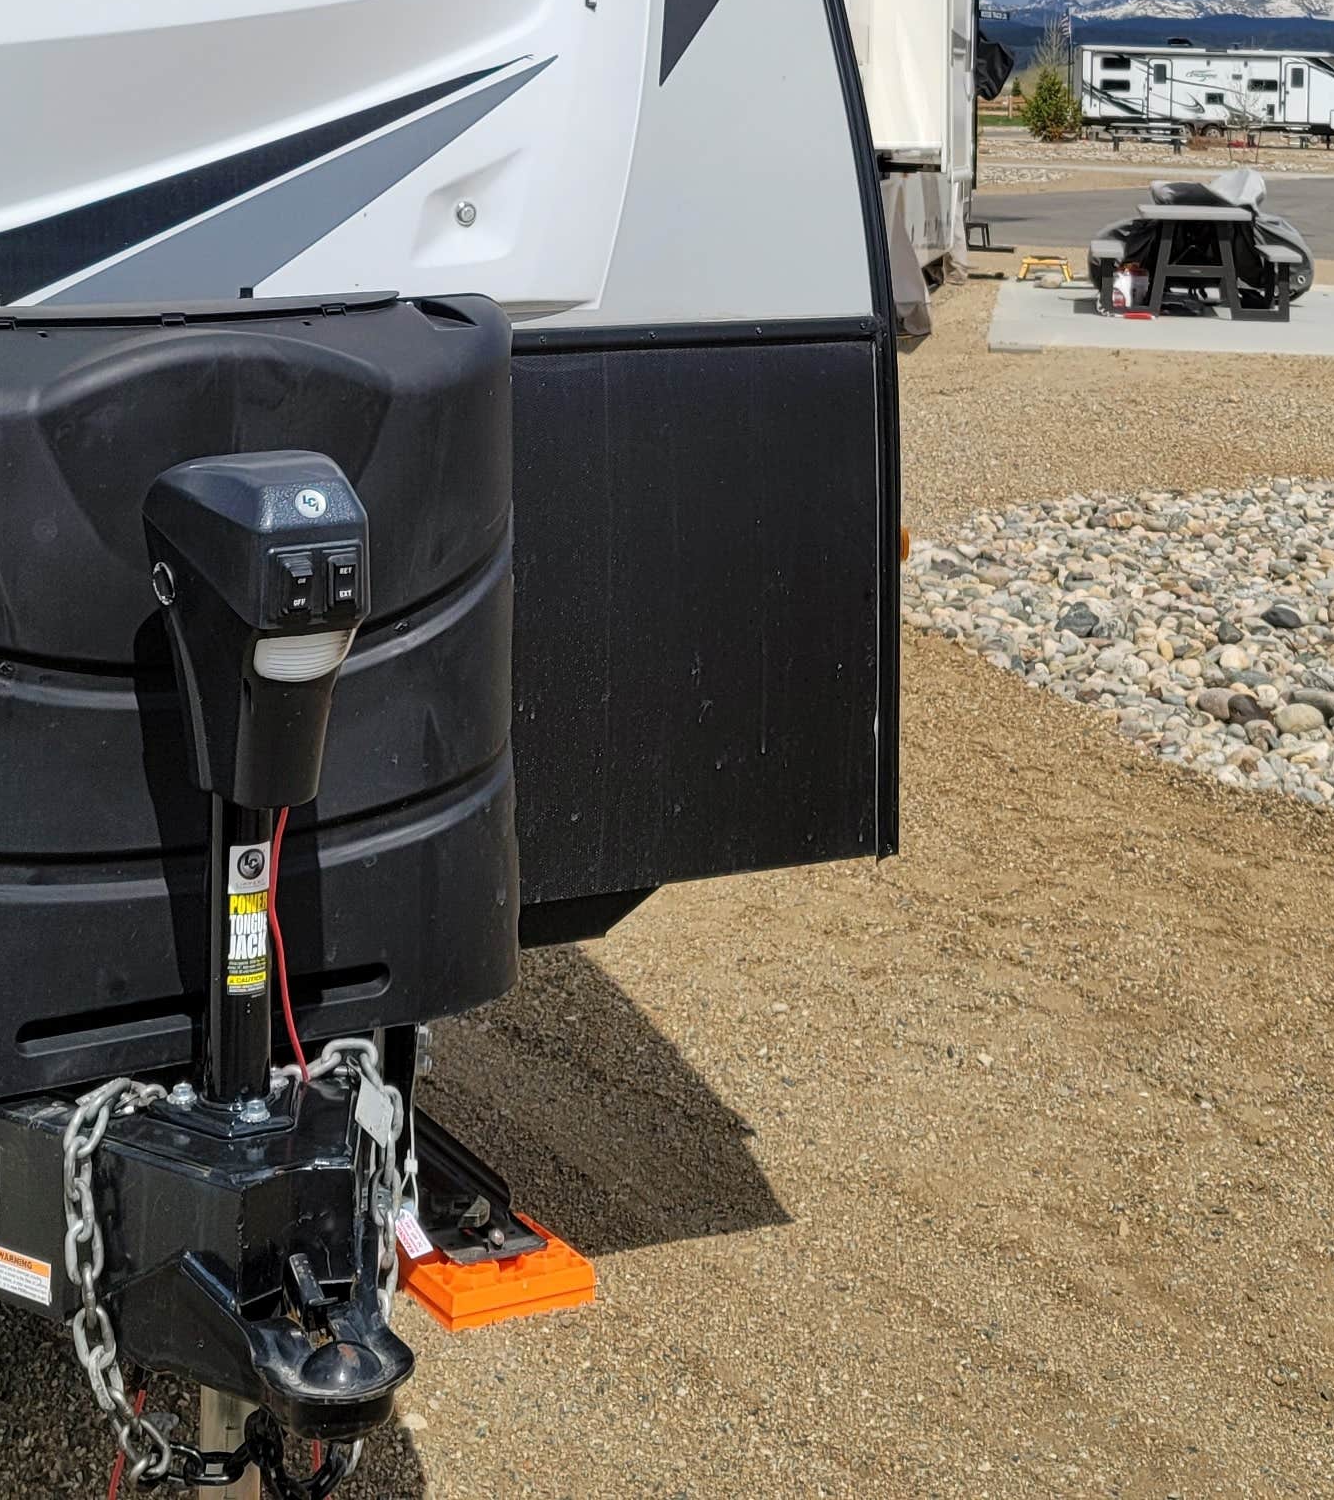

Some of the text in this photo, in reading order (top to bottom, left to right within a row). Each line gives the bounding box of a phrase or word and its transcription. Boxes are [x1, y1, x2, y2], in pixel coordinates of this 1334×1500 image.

[229, 891, 268, 915] POWER
[229, 911, 267, 935] TONGUE
[228, 934, 267, 960] JACK
